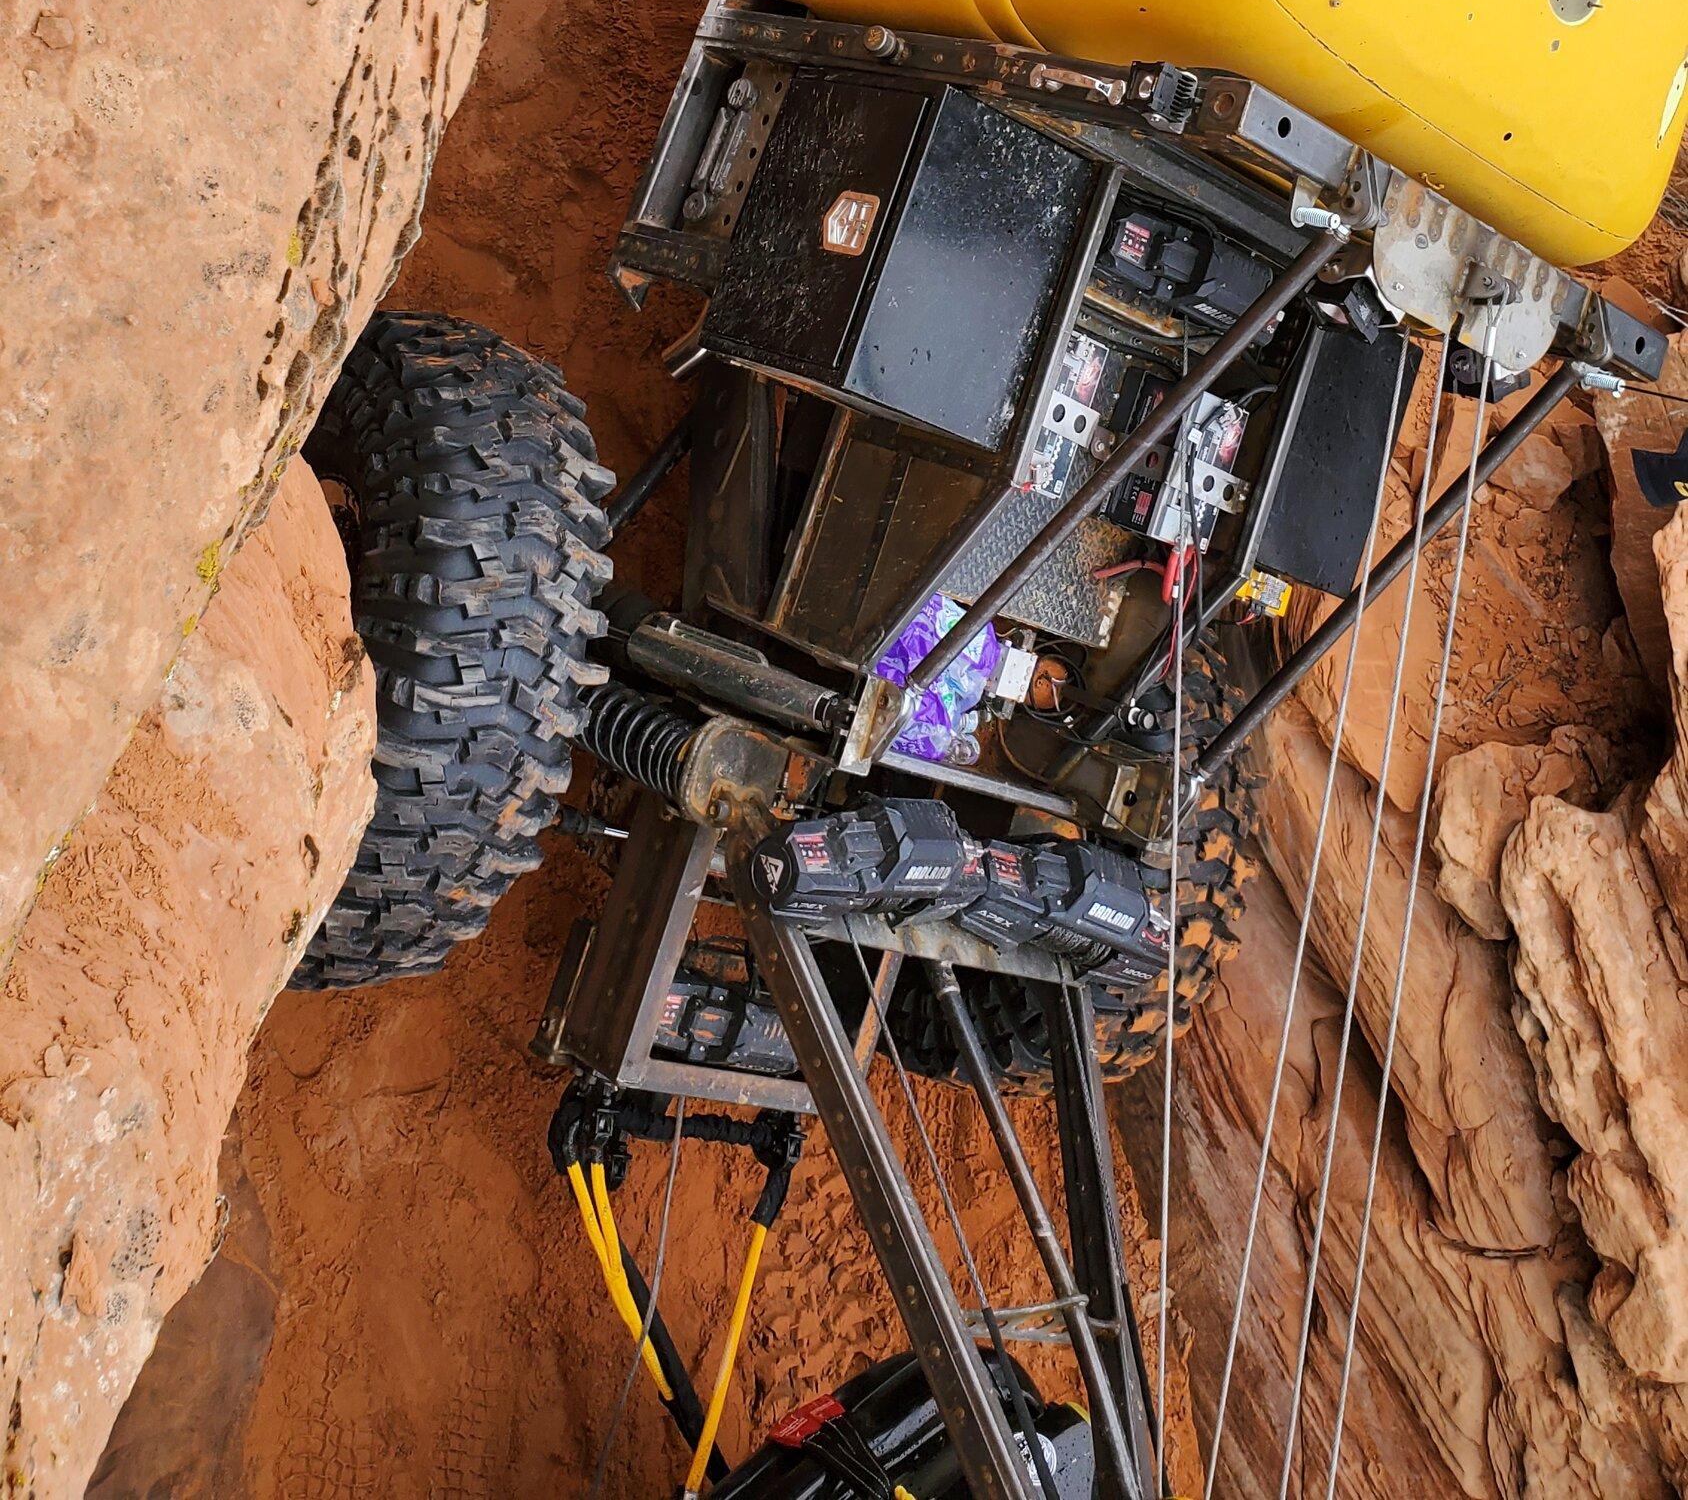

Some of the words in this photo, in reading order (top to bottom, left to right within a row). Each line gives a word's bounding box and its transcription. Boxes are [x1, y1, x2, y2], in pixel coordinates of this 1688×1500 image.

[905, 865, 952, 880] BADLAND
[788, 902, 827, 911] APEX
[977, 910, 1014, 928] APEX
[1088, 902, 1136, 930] BADLAND
[1122, 967, 1153, 980] 12000
